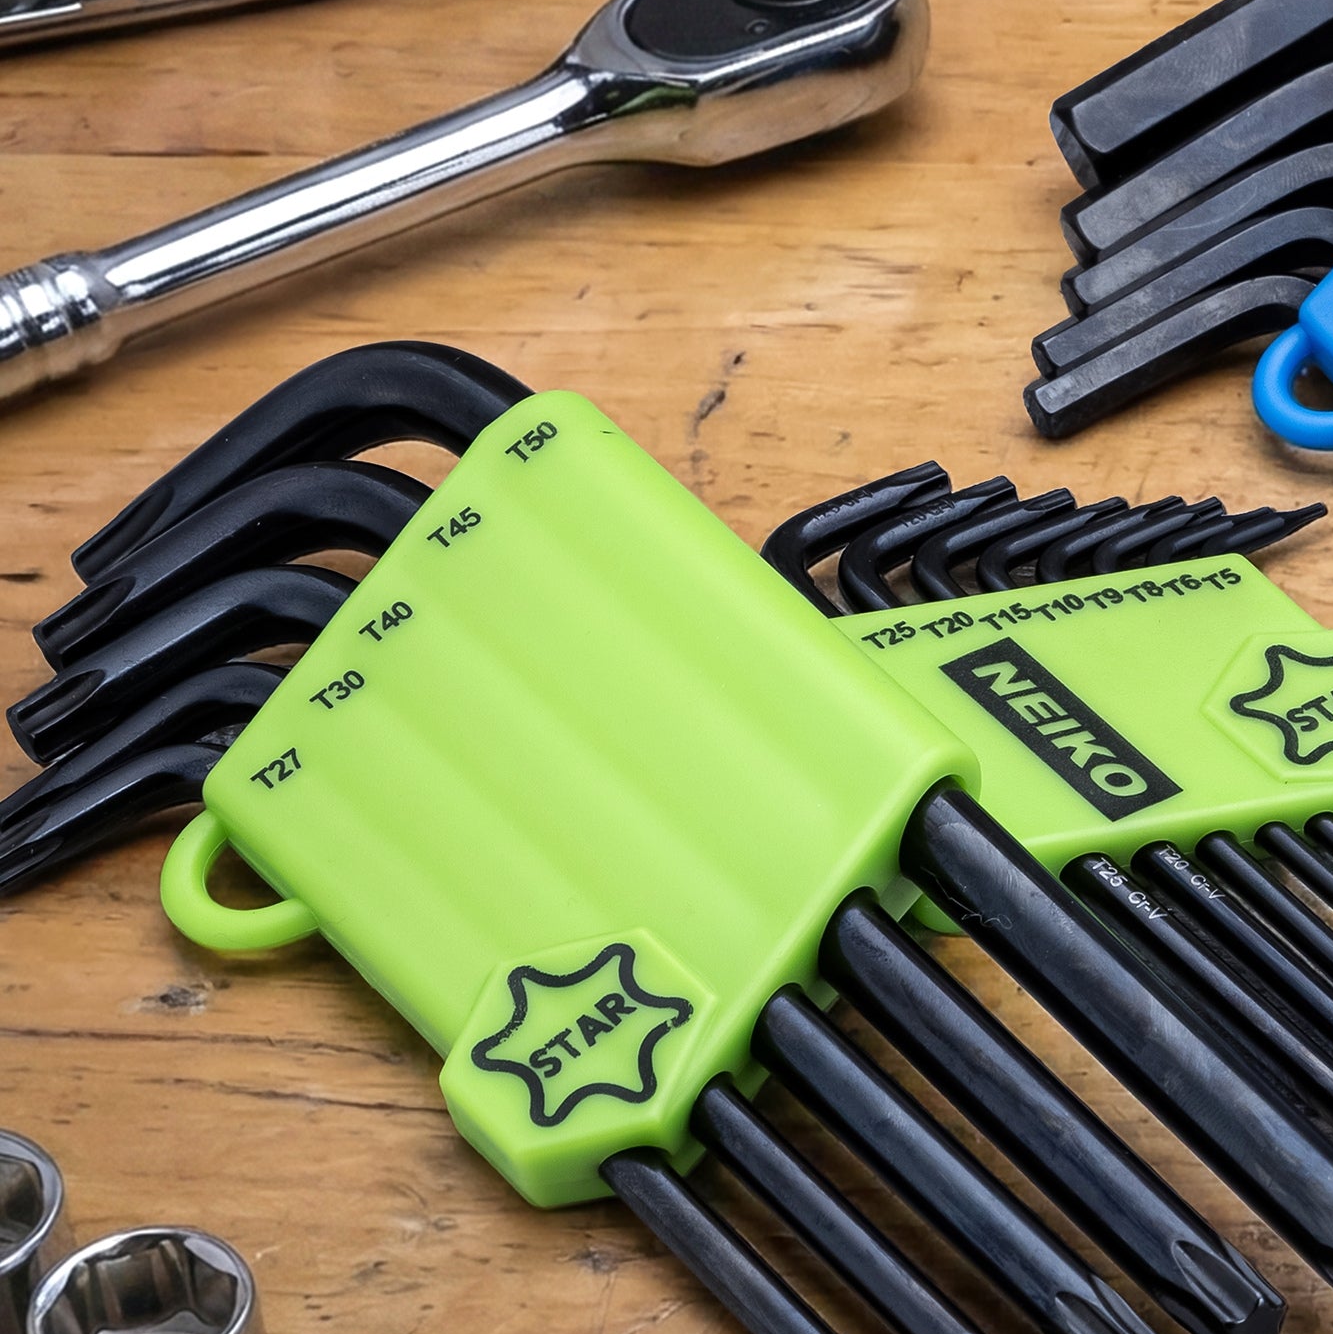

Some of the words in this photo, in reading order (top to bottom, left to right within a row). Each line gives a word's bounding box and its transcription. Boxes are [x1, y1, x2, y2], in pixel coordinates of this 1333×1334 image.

[505, 420, 558, 463] T50
[426, 506, 482, 550] T45
[358, 600, 414, 644] T40
[861, 621, 916, 650] T25
[920, 611, 974, 639] T20
[979, 602, 1032, 631] T15
[1030, 594, 1085, 621] T10
[1084, 588, 1124, 609] T9
[1123, 580, 1164, 602] T8
[1161, 574, 1203, 596] T6
[1201, 567, 1242, 590] T5
[309, 668, 366, 712] T30
[971, 661, 1148, 797] NEIKO
[250, 745, 303, 791] T27
[1092, 857, 1128, 887] T25
[1128, 891, 1169, 920] Cr-V
[1158, 844, 1190, 871] T20
[1190, 874, 1226, 900] Cr-V
[528, 990, 638, 1079] STAR
